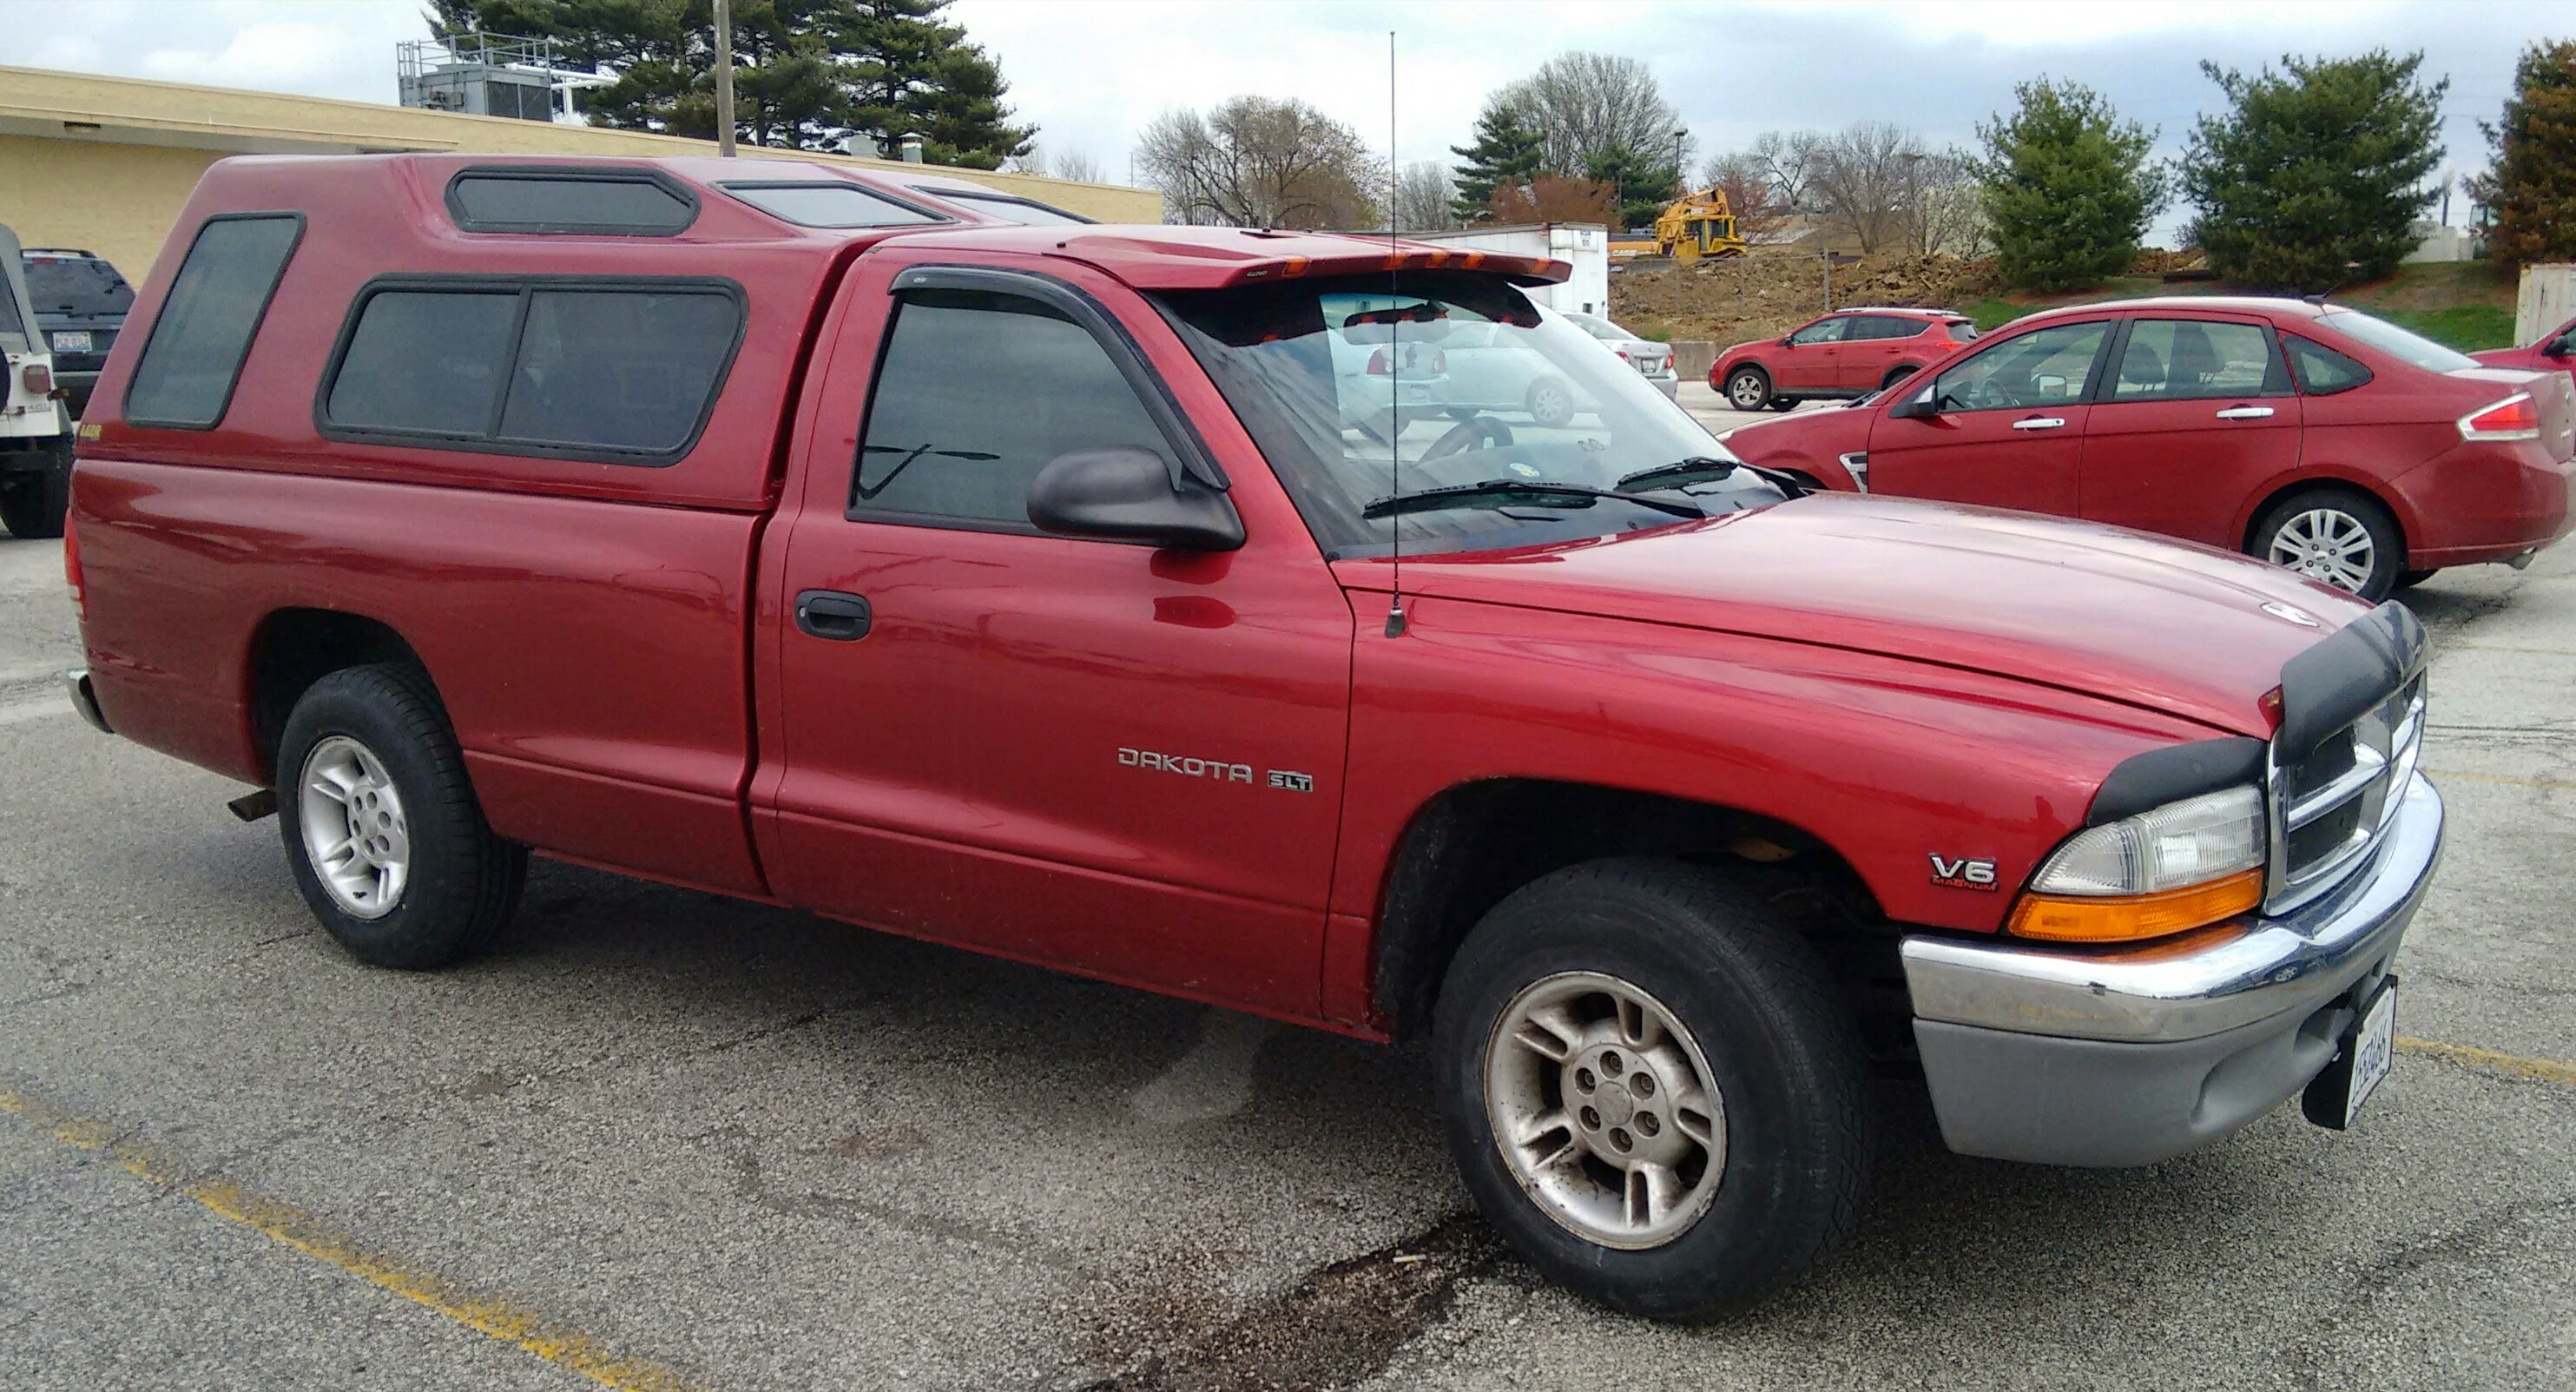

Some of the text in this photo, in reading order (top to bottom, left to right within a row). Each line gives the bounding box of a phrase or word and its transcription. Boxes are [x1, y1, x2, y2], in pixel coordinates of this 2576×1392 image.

[1117, 747, 1311, 791] DAKOTA SLT
[1930, 856, 1995, 884] V6
[1932, 877, 1997, 891] MAGNUM
